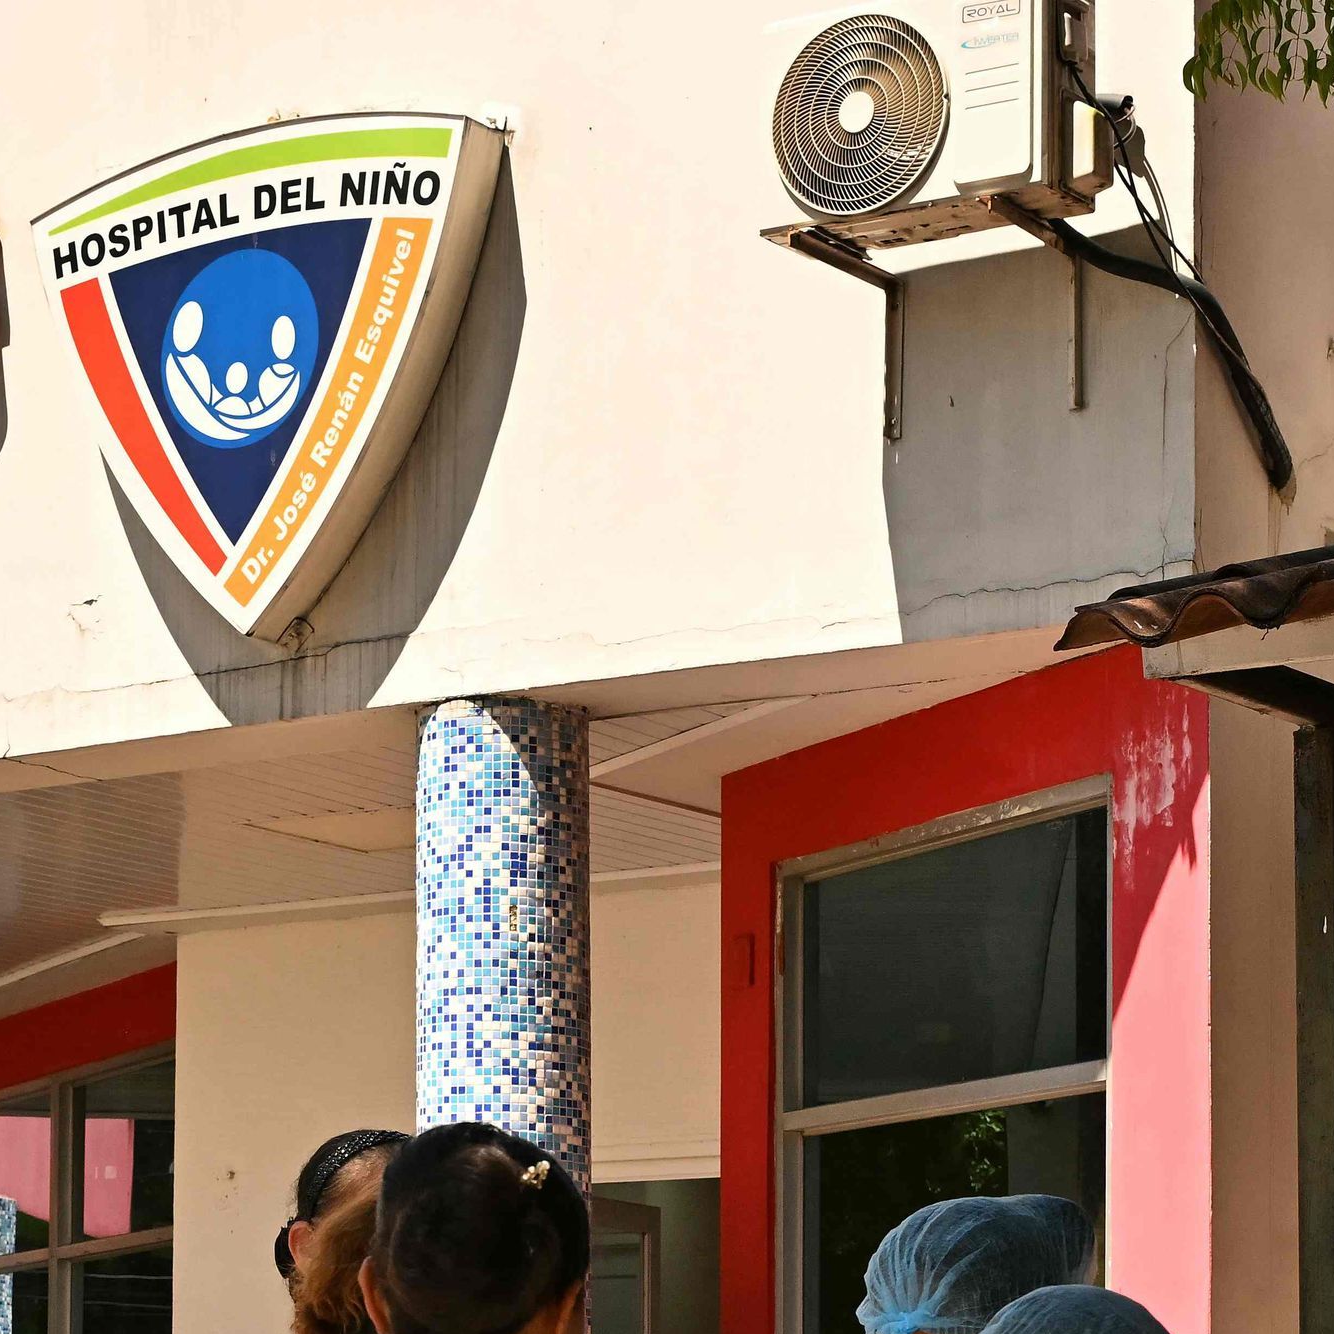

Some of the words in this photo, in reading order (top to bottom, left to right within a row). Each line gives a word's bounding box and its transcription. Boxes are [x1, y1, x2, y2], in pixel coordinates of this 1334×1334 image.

[966, 3, 1016, 18] ROYAL
[53, 192, 240, 280] HOSPITAL
[253, 171, 325, 222] DEL
[339, 161, 441, 208] NIÑO
[241, 546, 275, 585] Dr.
[272, 472, 316, 542] José
[309, 373, 363, 468] Renán
[354, 228, 416, 363] Esquivel
